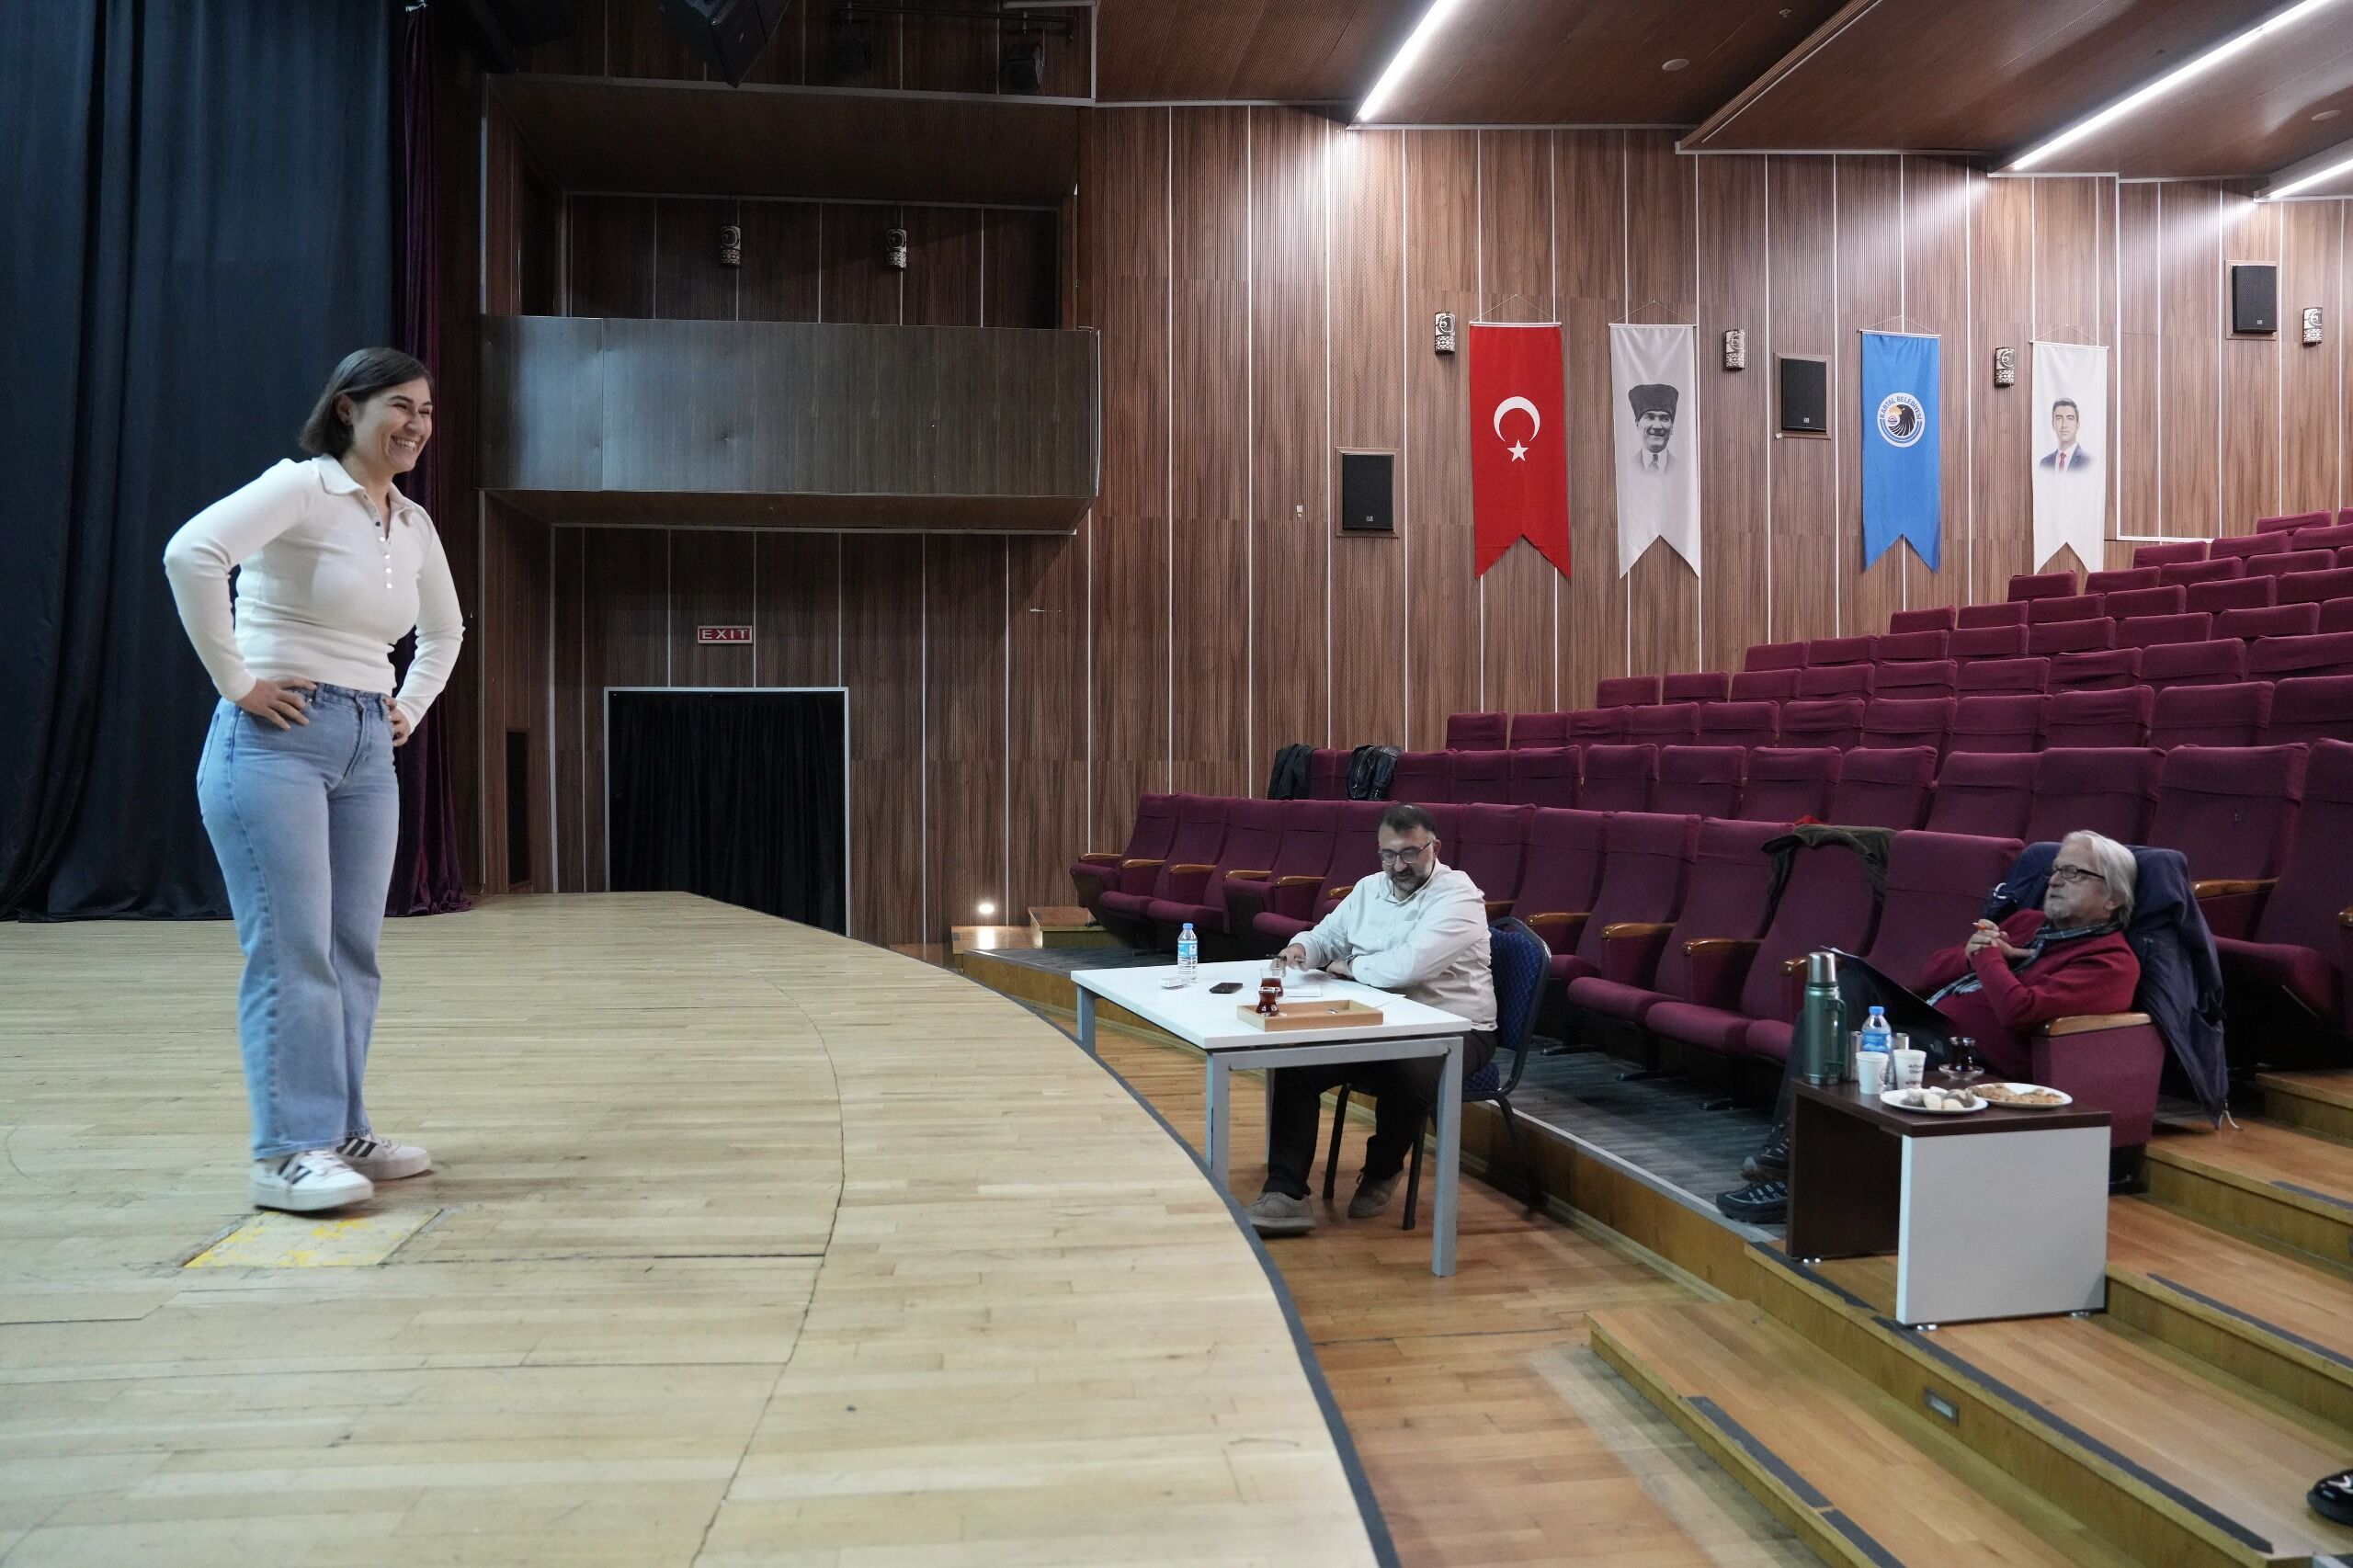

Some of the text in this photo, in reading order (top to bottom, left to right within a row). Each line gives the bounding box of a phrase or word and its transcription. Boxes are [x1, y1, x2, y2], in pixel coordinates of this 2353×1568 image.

[1879, 395, 1923, 420] KARTAL BELEDİYESİ
[701, 629, 748, 640] EXIT
